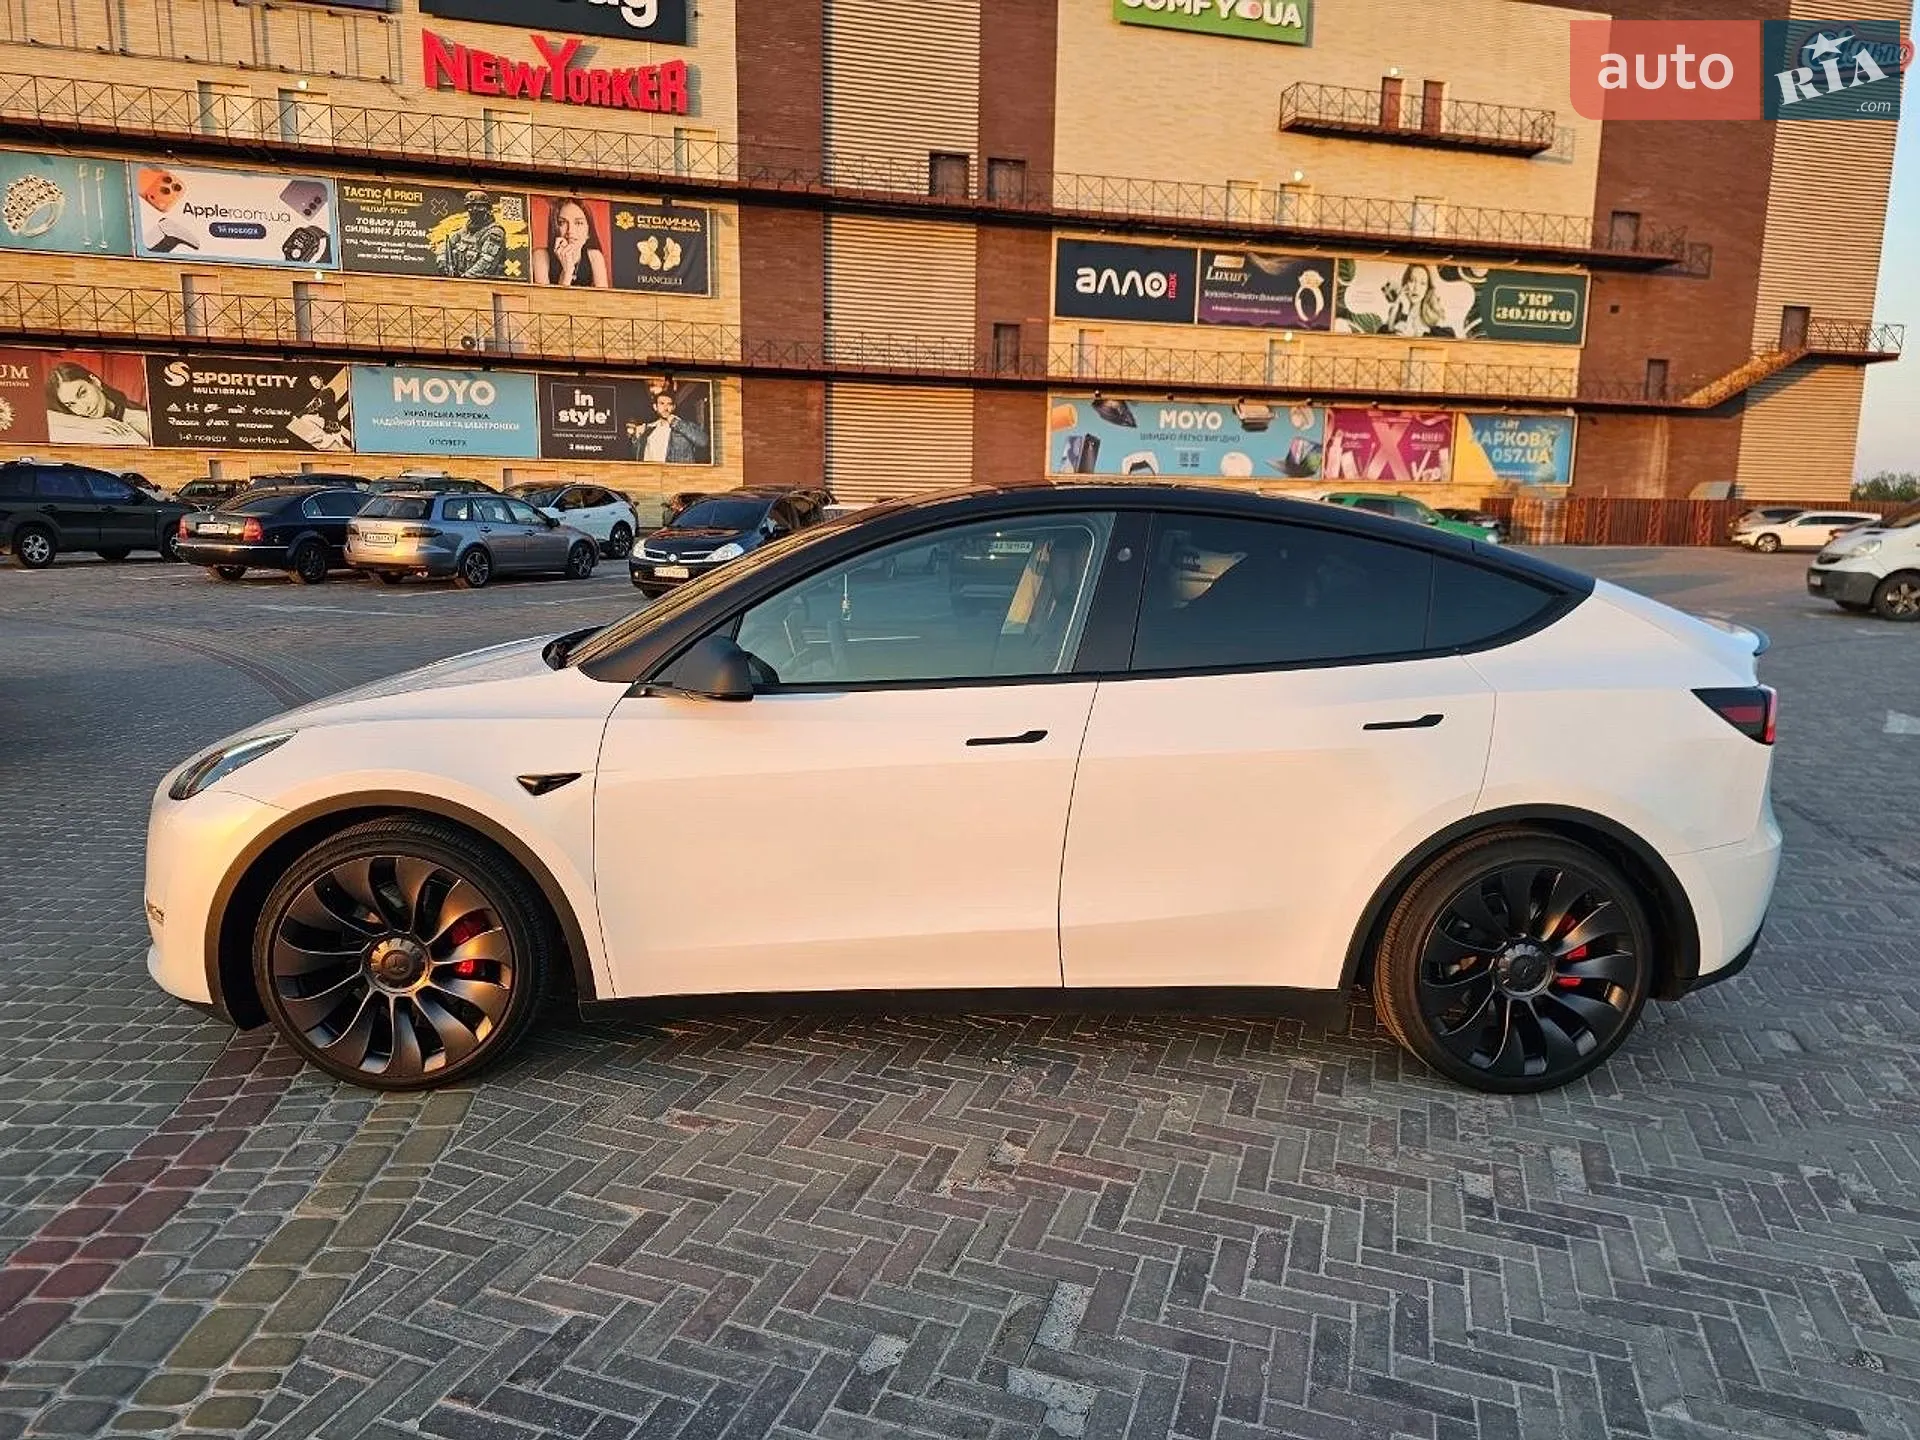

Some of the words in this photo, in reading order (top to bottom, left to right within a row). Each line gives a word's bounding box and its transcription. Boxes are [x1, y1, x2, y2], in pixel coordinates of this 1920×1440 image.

[343, 186, 382, 199] TACTIC
[384, 187, 393, 201] 4
[394, 191, 424, 203] PROFI
[182, 202, 291, 223] Appleroom.ua
[356, 217, 394, 227] ТОВАРИ
[397, 220, 417, 229] ДЛЯ
[637, 215, 701, 228] СТОЛИЧНА
[344, 225, 391, 236] СИЛЬНИХ
[392, 228, 427, 238] ДУХОМ
[1205, 265, 1252, 287] Luxury
[1518, 291, 1554, 306] УКР
[1495, 307, 1573, 323] ЗОЛОТО
[192, 372, 298, 389] SPORTCITY
[192, 386, 257, 396] MULTIBRAND
[393, 376, 496, 406] MOYO
[574, 389, 594, 407] in
[1159, 409, 1223, 430] MOYO
[1491, 446, 1550, 464] 057.UA
